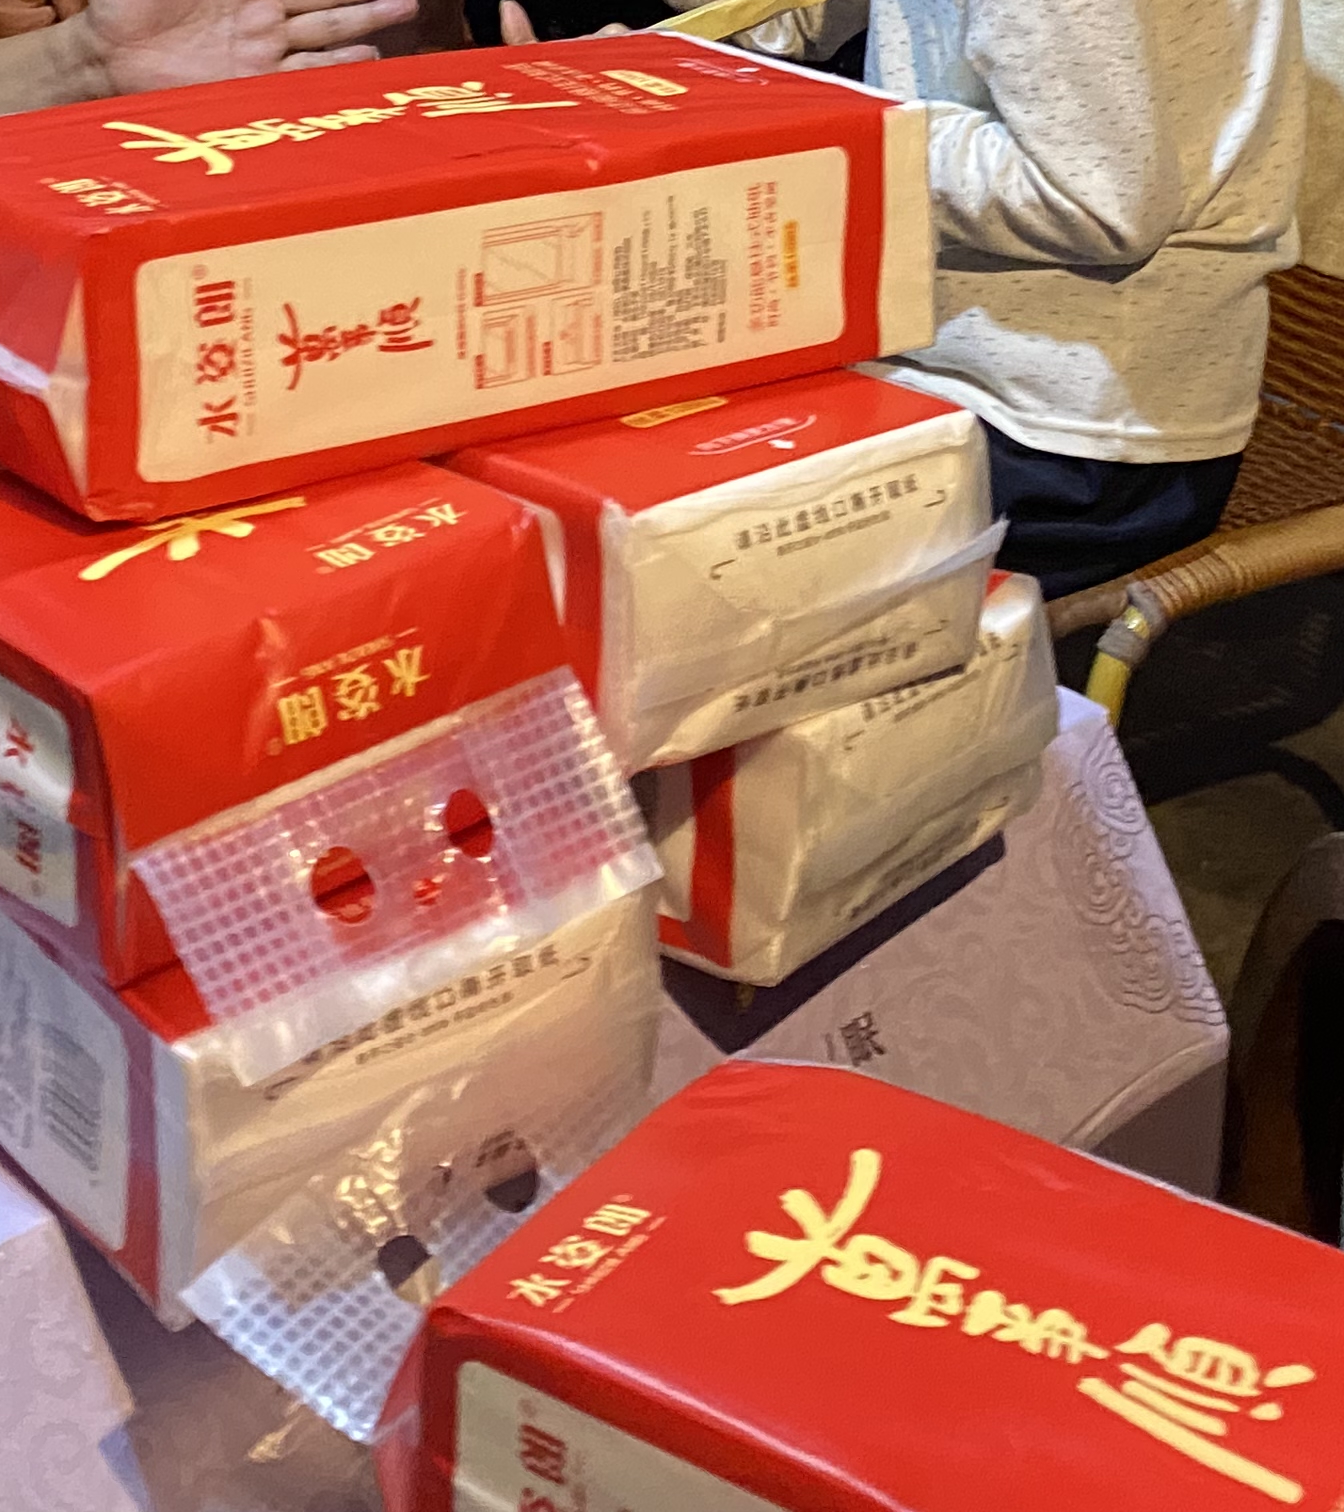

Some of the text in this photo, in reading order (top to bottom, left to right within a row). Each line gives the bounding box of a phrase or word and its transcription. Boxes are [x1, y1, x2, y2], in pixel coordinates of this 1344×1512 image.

[276, 645, 431, 746] 水姿朗
[506, 1203, 652, 1308] 水姿朗
